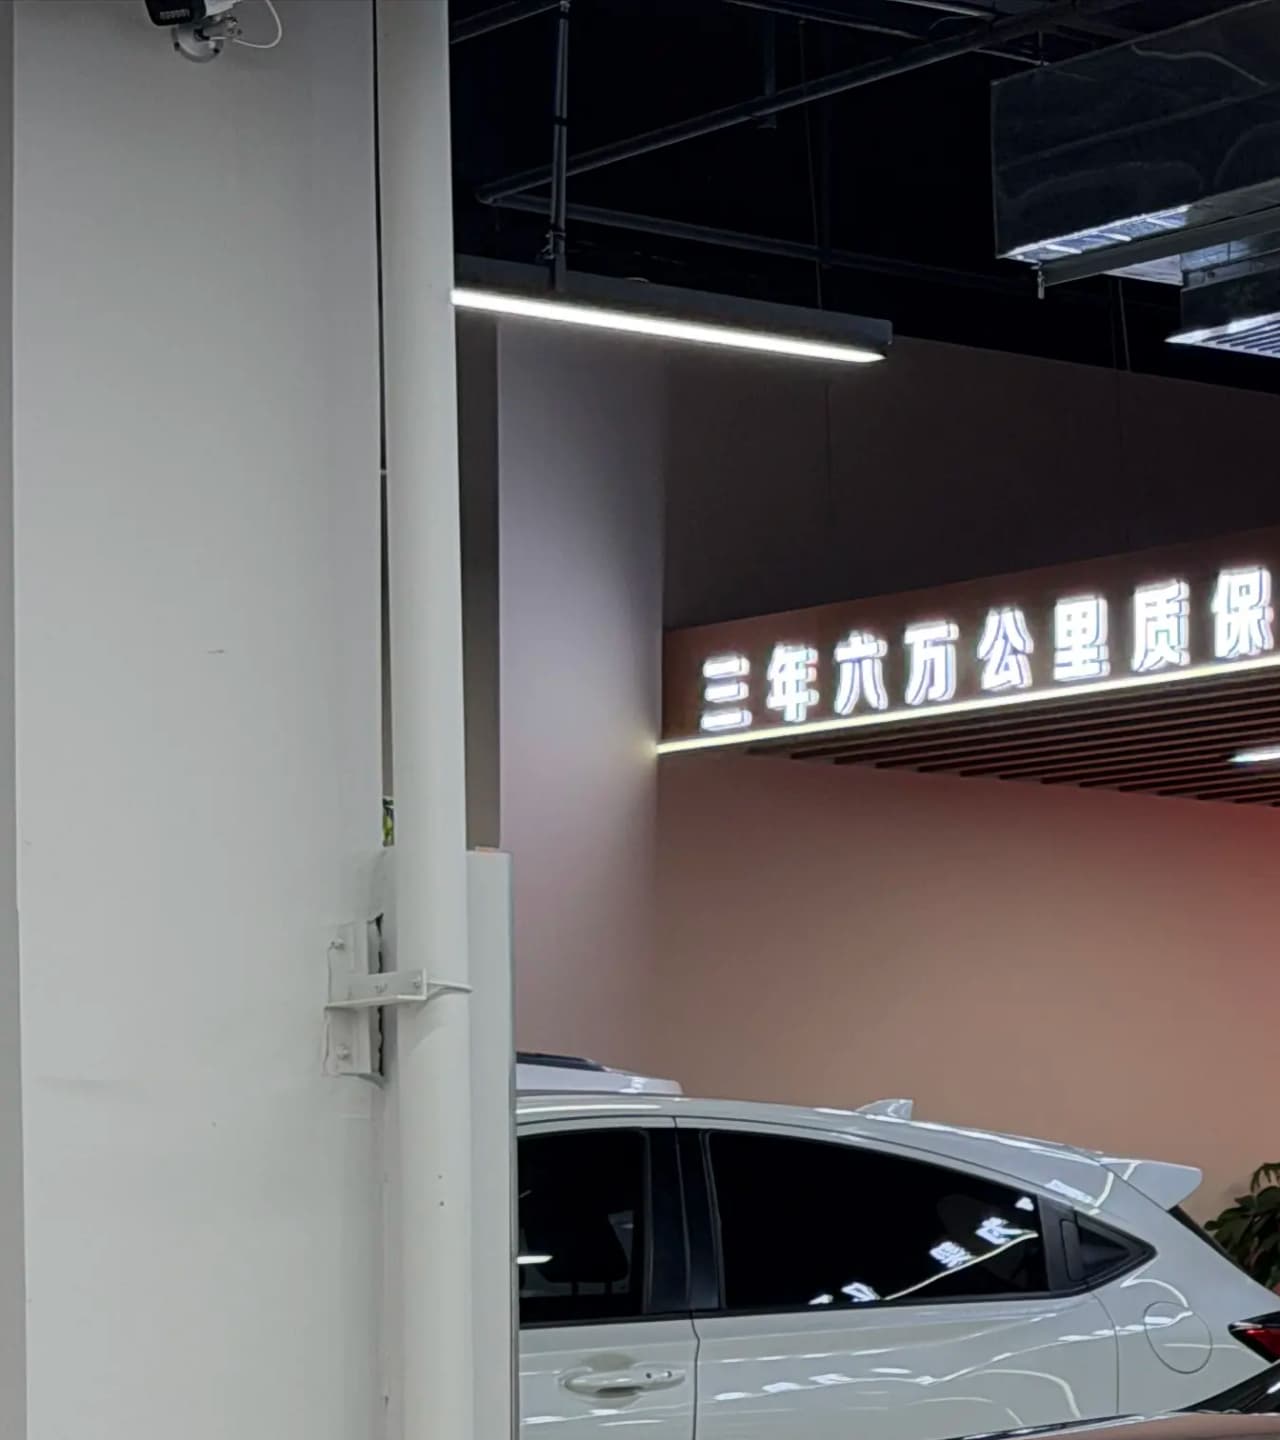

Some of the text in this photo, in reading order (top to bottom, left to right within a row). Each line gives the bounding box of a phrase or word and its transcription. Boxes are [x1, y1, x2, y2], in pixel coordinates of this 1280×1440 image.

[701, 568, 1274, 732] 三年六万公里质保
